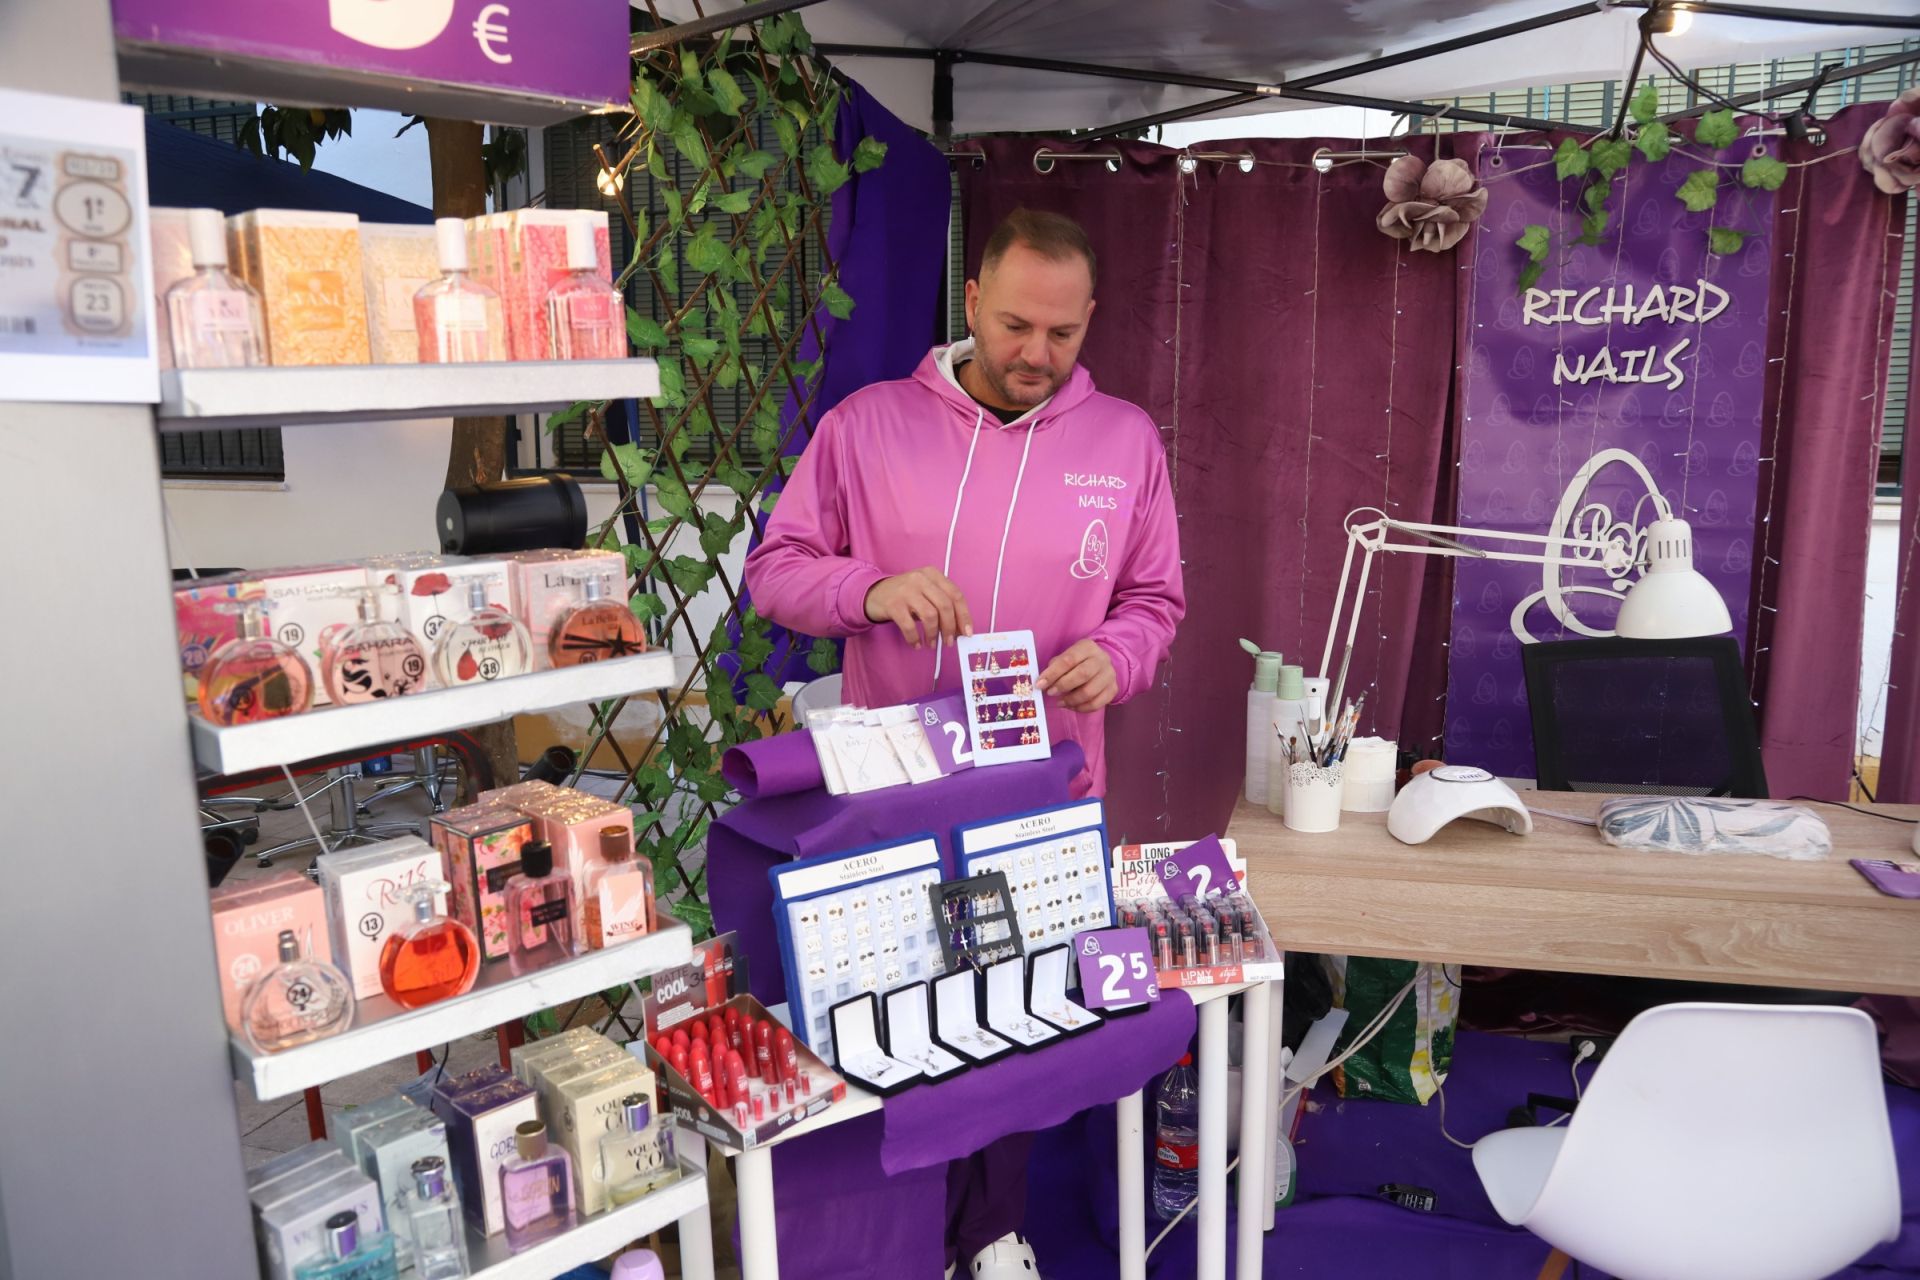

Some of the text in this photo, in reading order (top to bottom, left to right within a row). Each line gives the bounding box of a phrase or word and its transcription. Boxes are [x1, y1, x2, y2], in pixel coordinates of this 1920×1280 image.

[472, 4, 512, 64] €
[1523, 278, 1730, 326] RICHARD
[1553, 338, 1690, 391] NAILS
[1063, 472, 1128, 490] RICHARD
[1078, 494, 1118, 511] NAILS
[284, 628, 299, 643] 19
[344, 636, 414, 653] SAHARA
[407, 658, 420, 673] 19
[482, 662, 497, 676] 38
[943, 720, 973, 765] 2
[1019, 816, 1051, 830] ACERO
[1144, 847, 1170, 860] LONG
[843, 855, 878, 871] ACERO
[1187, 864, 1237, 904] 2 €
[224, 906, 294, 936] OLIVER
[364, 917, 379, 932] 13
[654, 966, 689, 989] MATTE
[290, 987, 307, 1002] 24
[656, 976, 689, 1005] COOL
[1146, 983, 1158, 998] €
